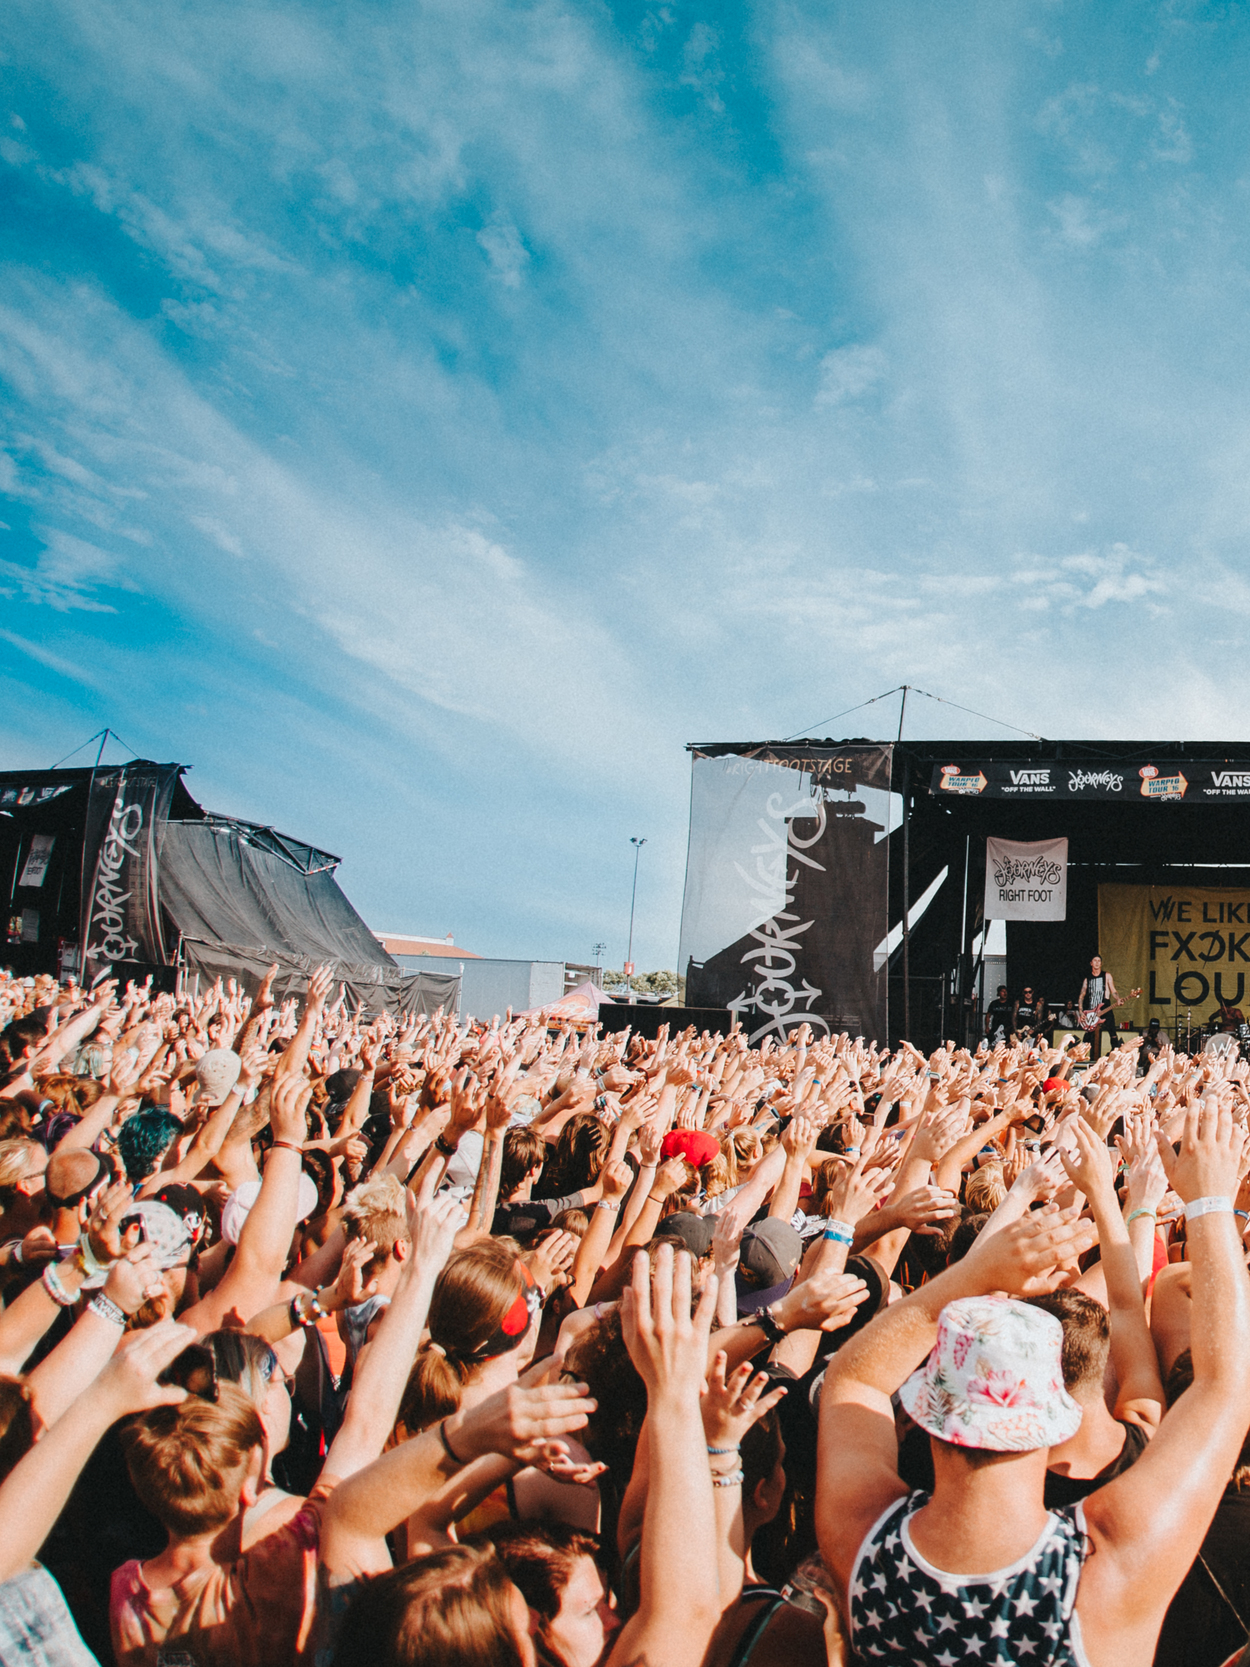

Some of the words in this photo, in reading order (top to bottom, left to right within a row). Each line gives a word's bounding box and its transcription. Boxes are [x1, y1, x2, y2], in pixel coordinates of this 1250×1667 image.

[1009, 769, 1051, 785] VANS
[1067, 769, 1124, 792] JOURNEYS
[1148, 777, 1180, 788] WARPED
[1148, 785, 1168, 794] TOUR
[993, 855, 1062, 887] JOURNEYS
[999, 889, 1026, 902] RIGHT
[1028, 889, 1053, 902] FOOT
[1150, 895, 1192, 925] WE
